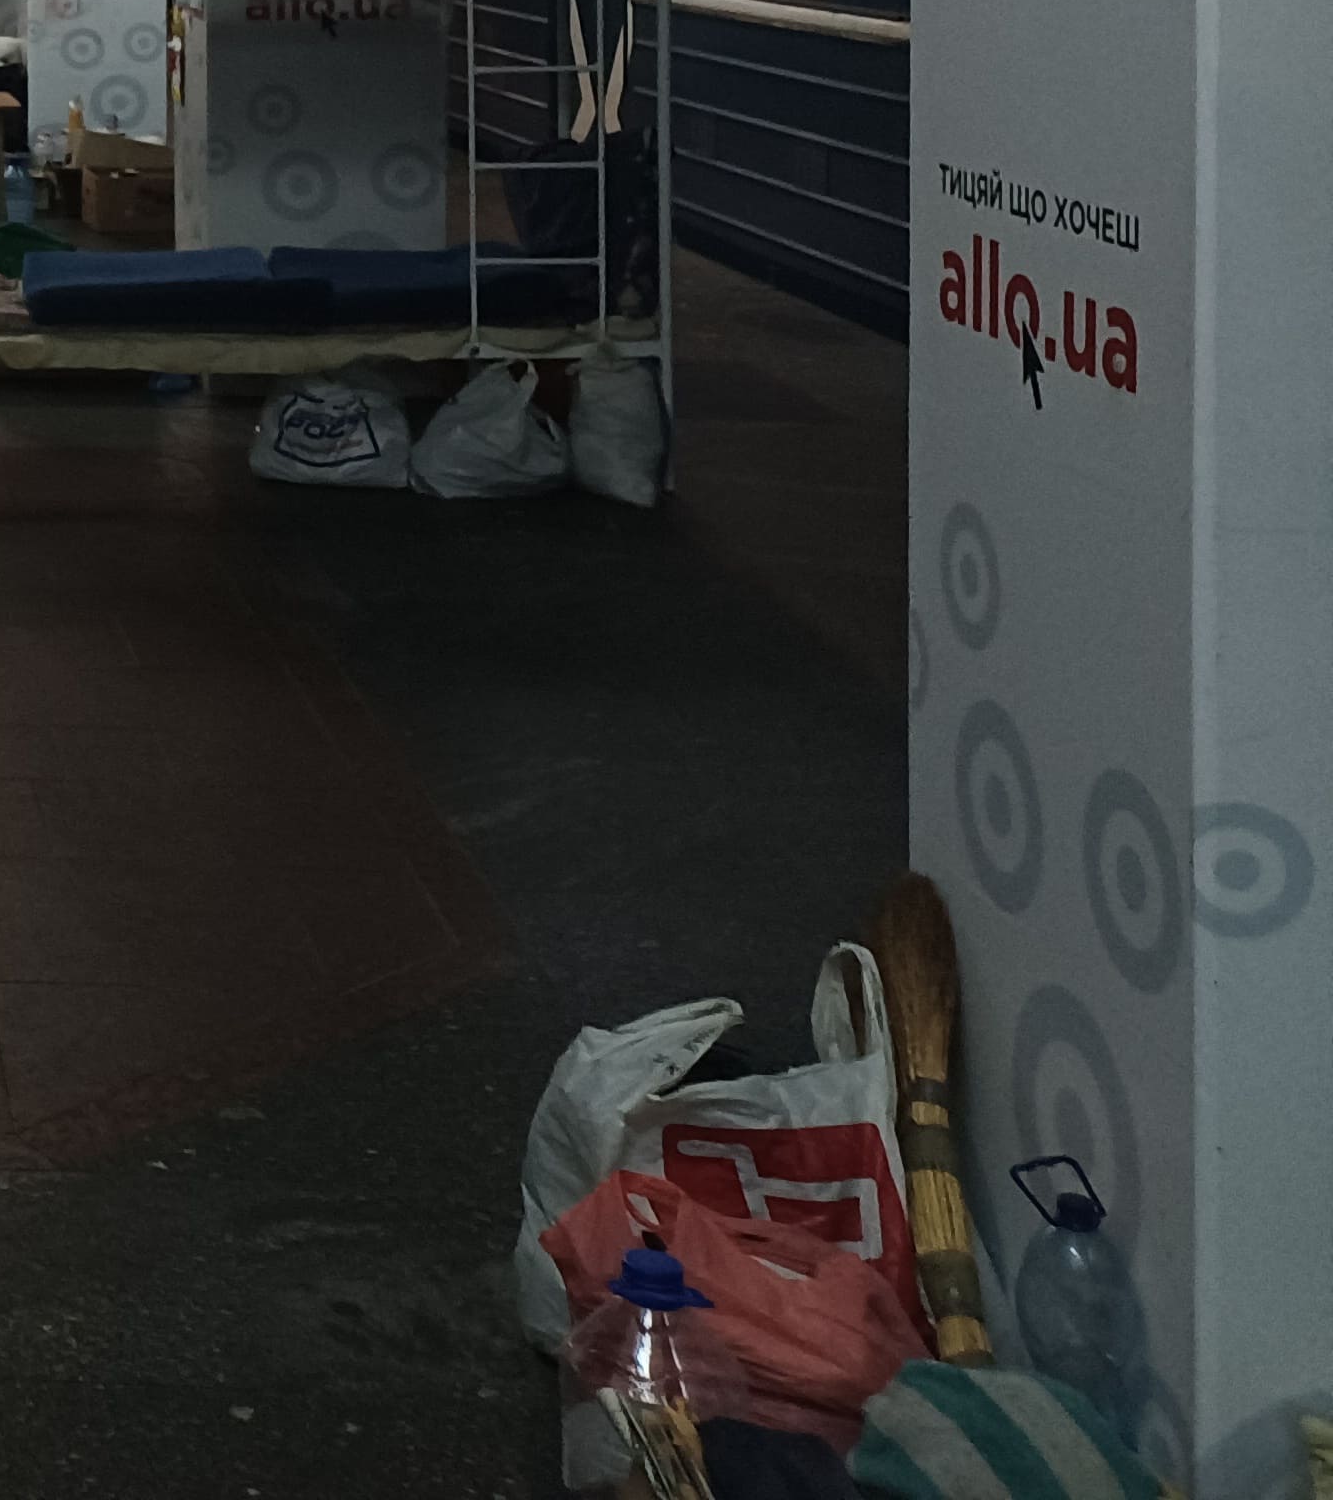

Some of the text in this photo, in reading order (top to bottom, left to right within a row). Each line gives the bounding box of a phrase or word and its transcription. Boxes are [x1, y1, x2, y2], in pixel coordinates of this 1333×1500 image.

[939, 163, 1139, 252] ТИЦЯЙ ЩО ХОЧЕШ
[939, 233, 1137, 393] allo.ua
